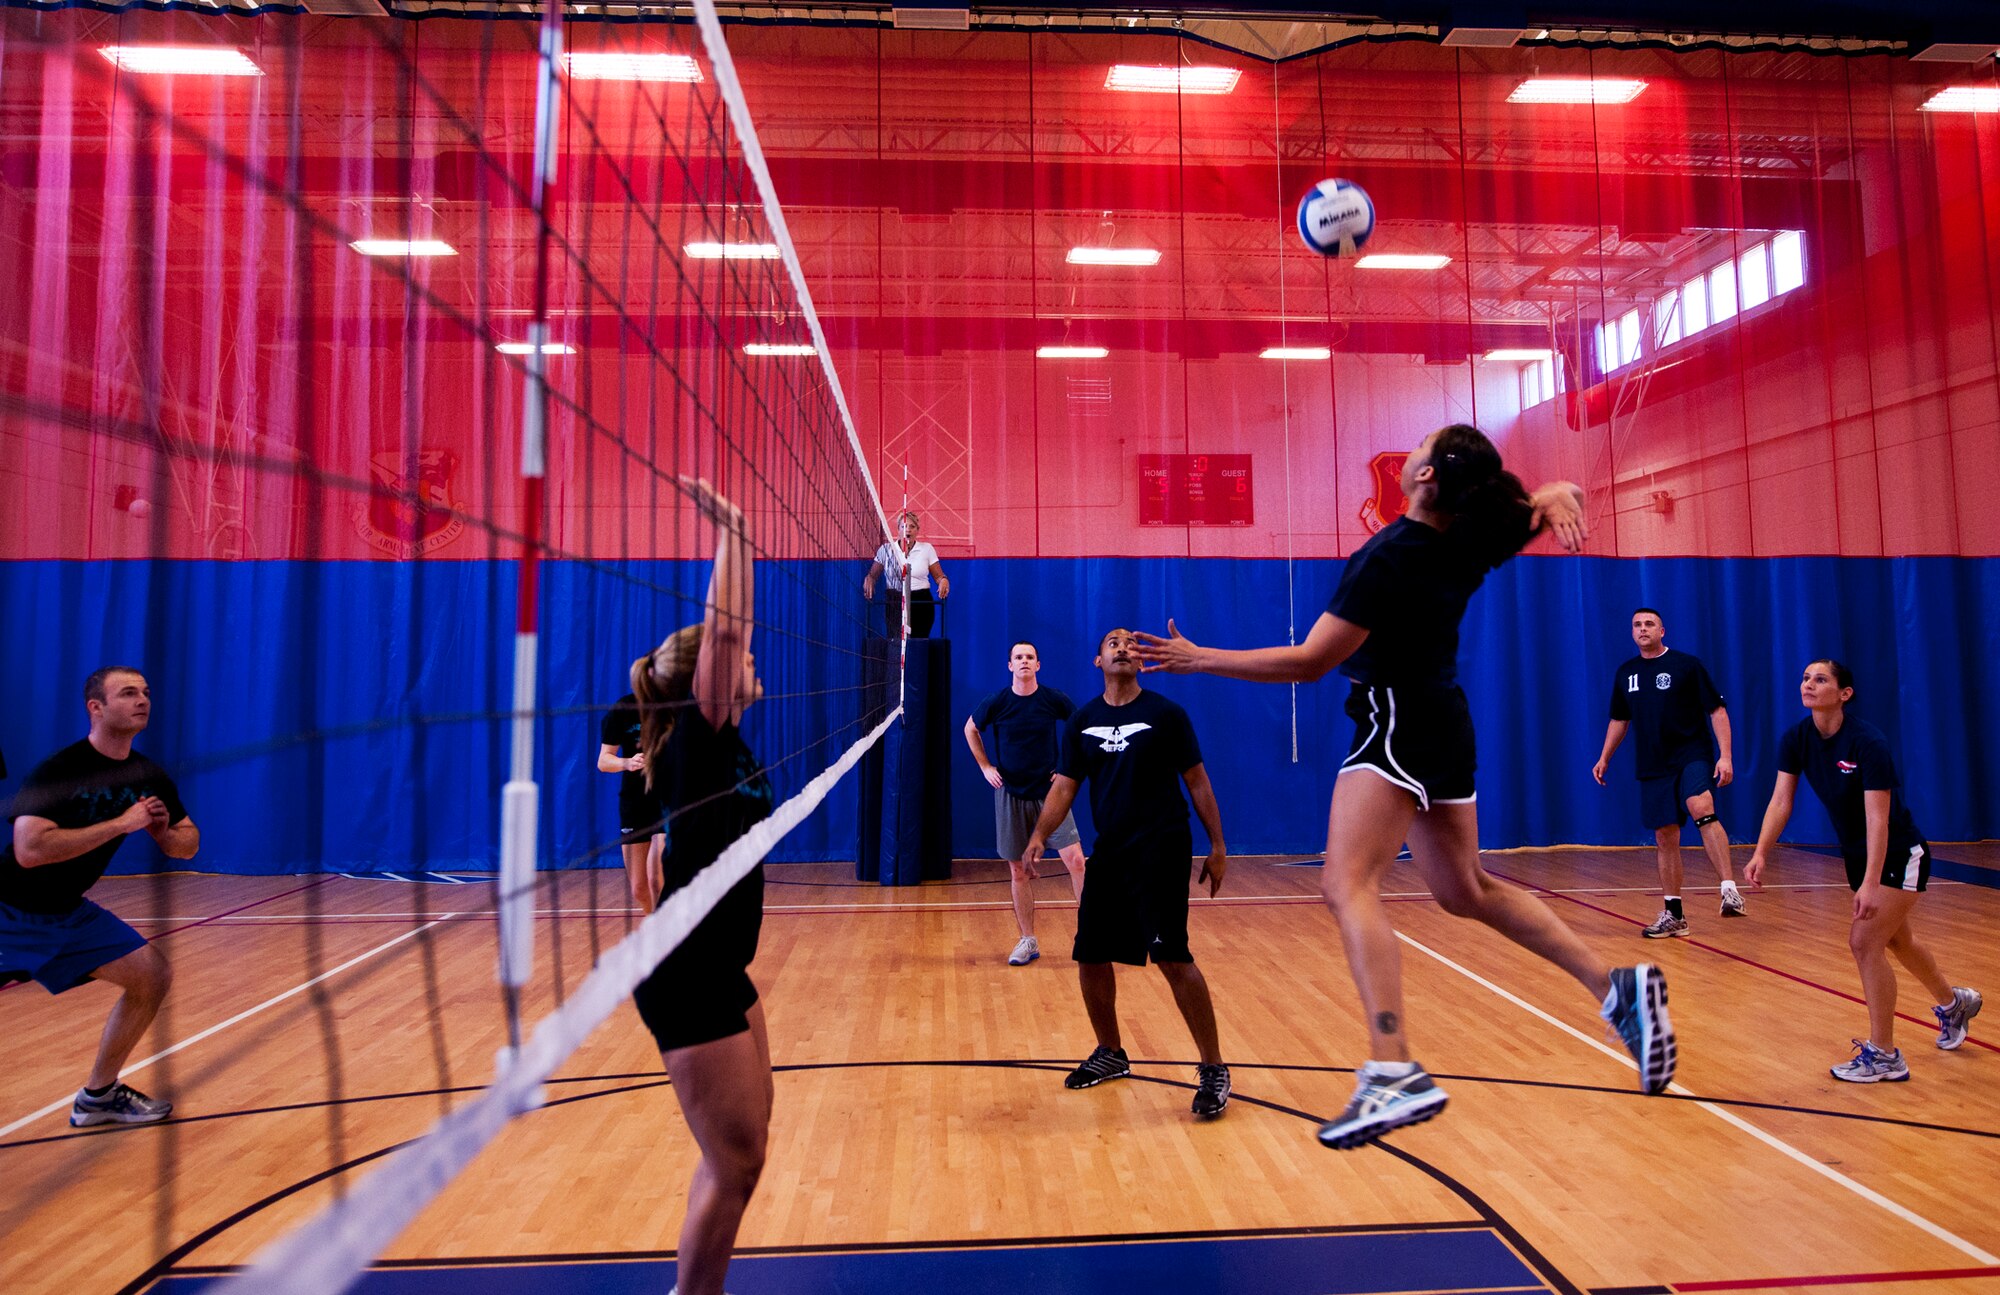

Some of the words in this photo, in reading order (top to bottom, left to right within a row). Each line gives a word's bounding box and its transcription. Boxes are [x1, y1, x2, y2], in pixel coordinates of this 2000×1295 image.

[1144, 469, 1168, 477] HOME
[1221, 469, 1247, 477] GUEST
[1236, 477, 1247, 493] 6
[430, 520, 461, 546] CENTER
[1627, 673, 1640, 693] 11
